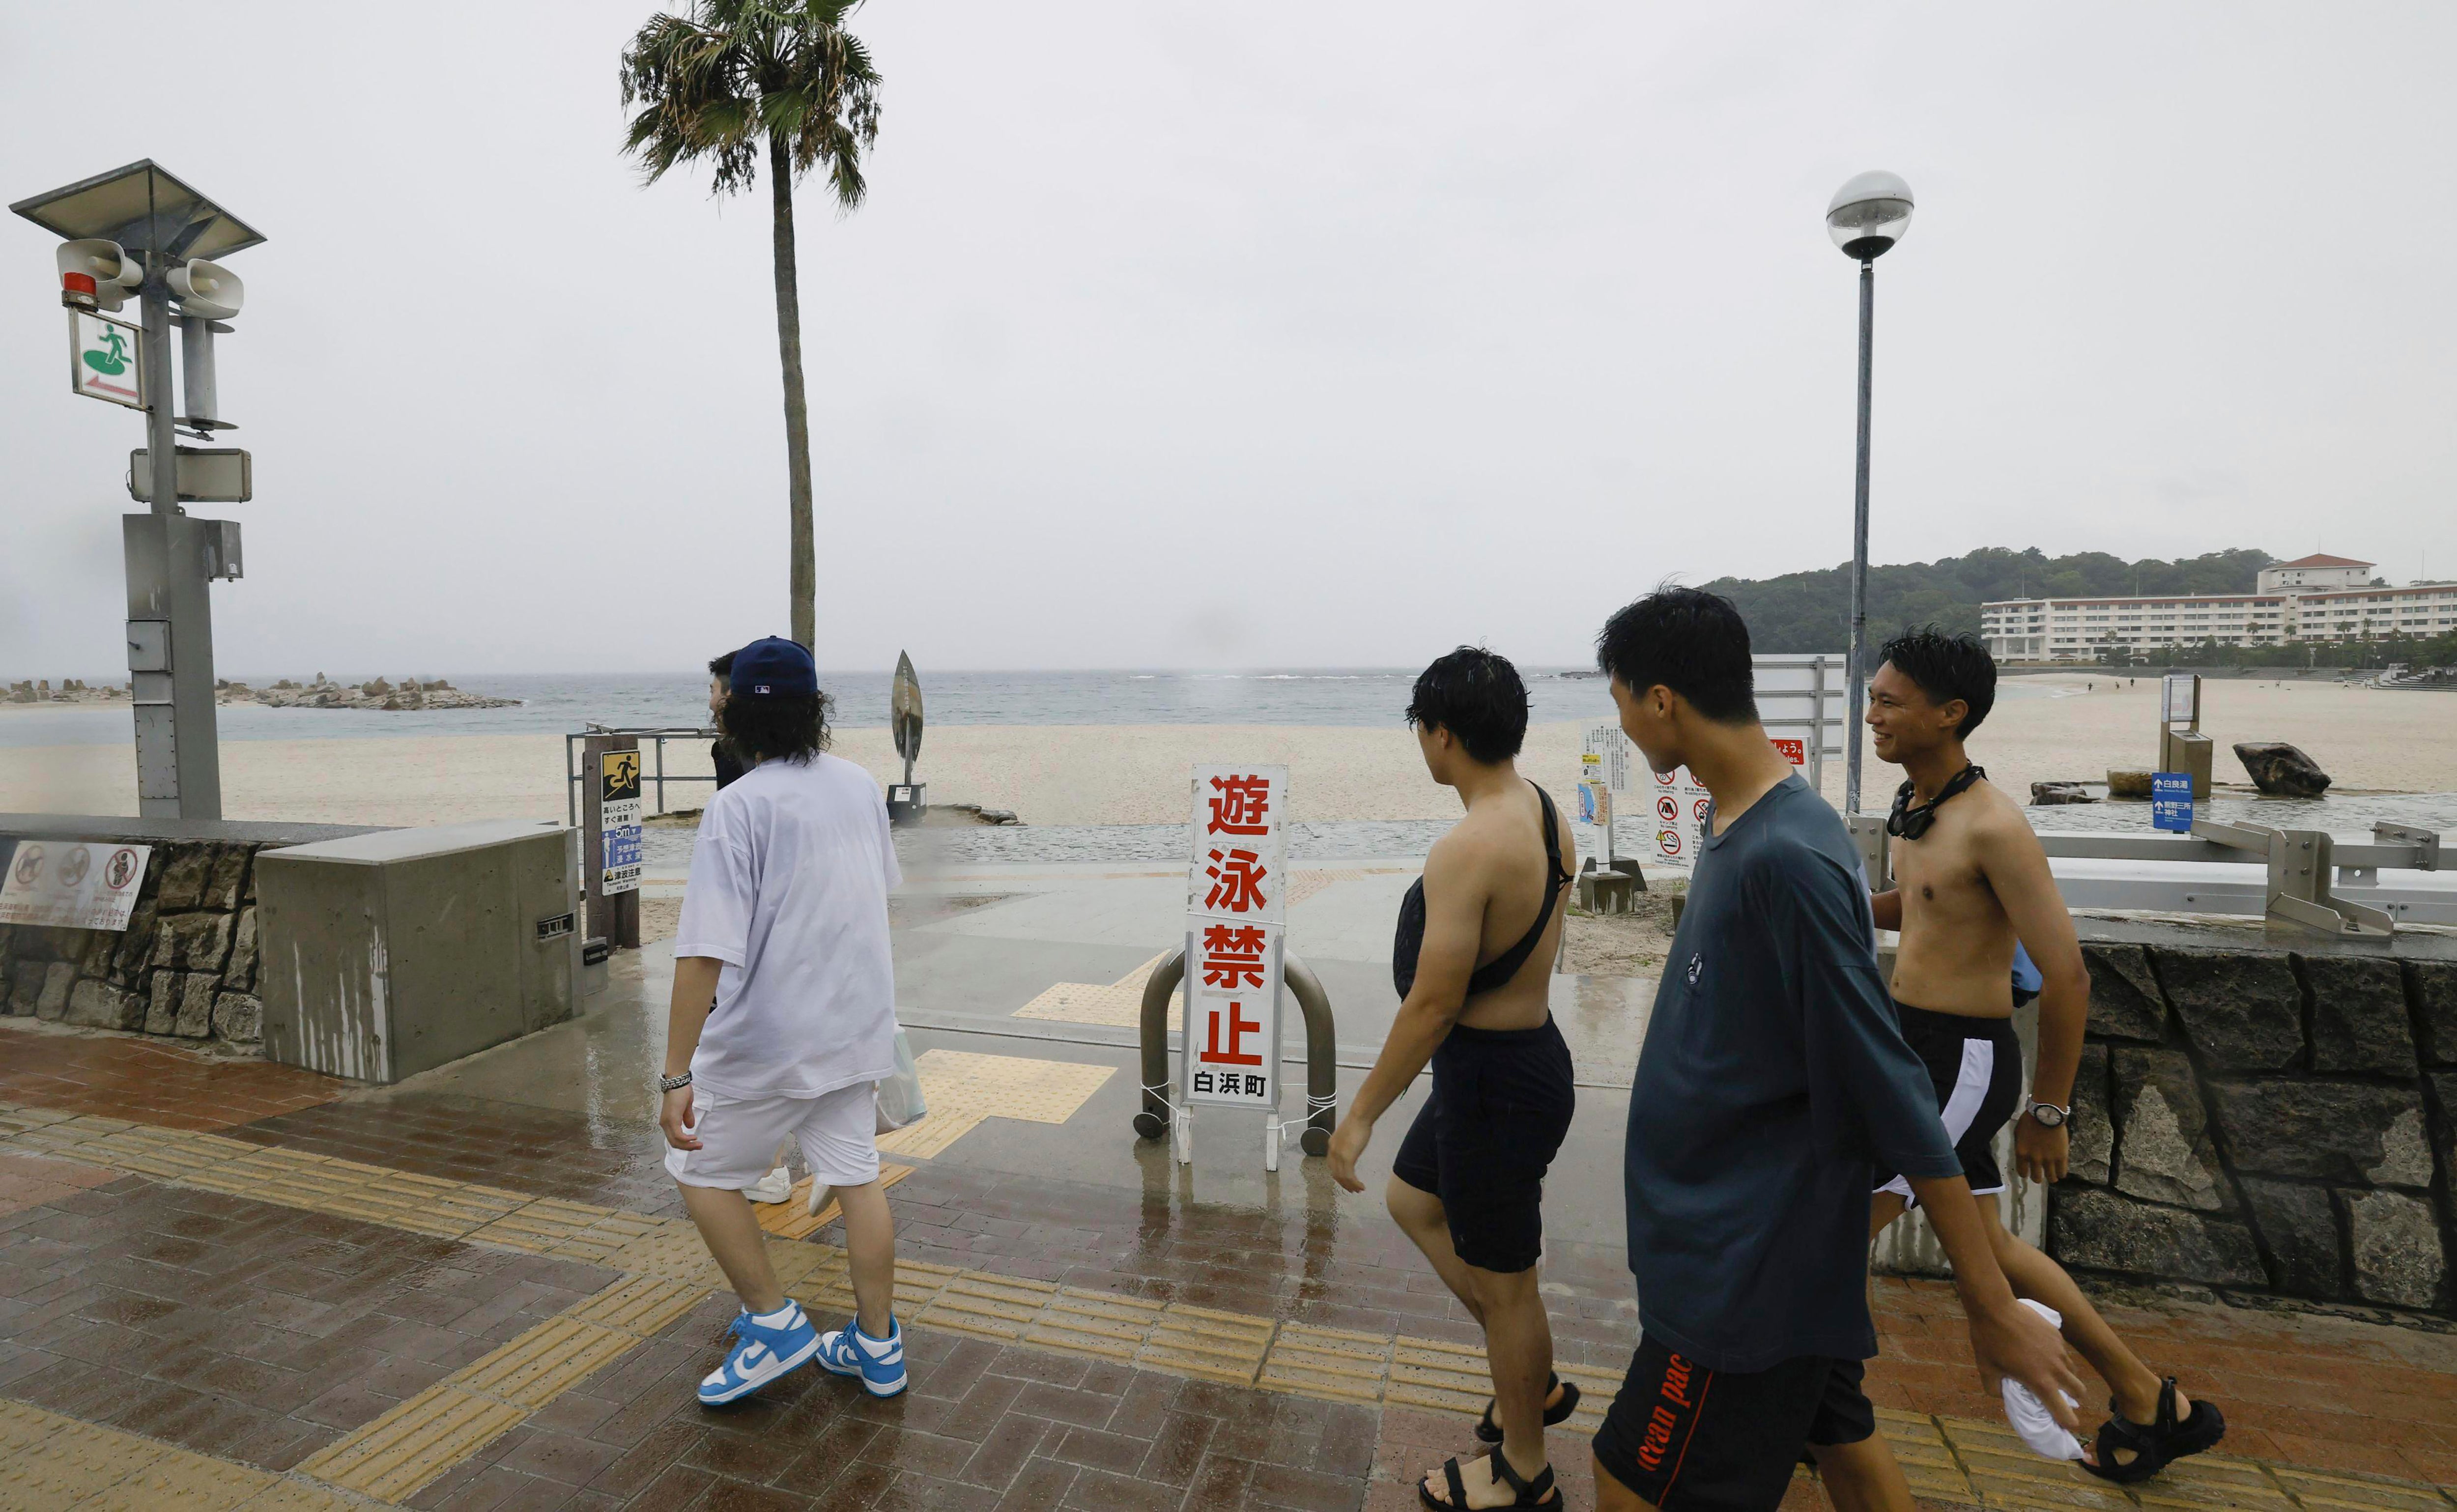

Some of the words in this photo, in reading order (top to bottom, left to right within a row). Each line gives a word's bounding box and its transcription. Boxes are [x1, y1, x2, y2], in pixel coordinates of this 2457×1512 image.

[603, 803, 640, 814] 高いところへ
[616, 826, 629, 838] 5m
[614, 867, 641, 880] 津波注意
[1199, 774, 1270, 1066] 遊泳禁止
[1194, 1071, 1266, 1097] 白浜町
